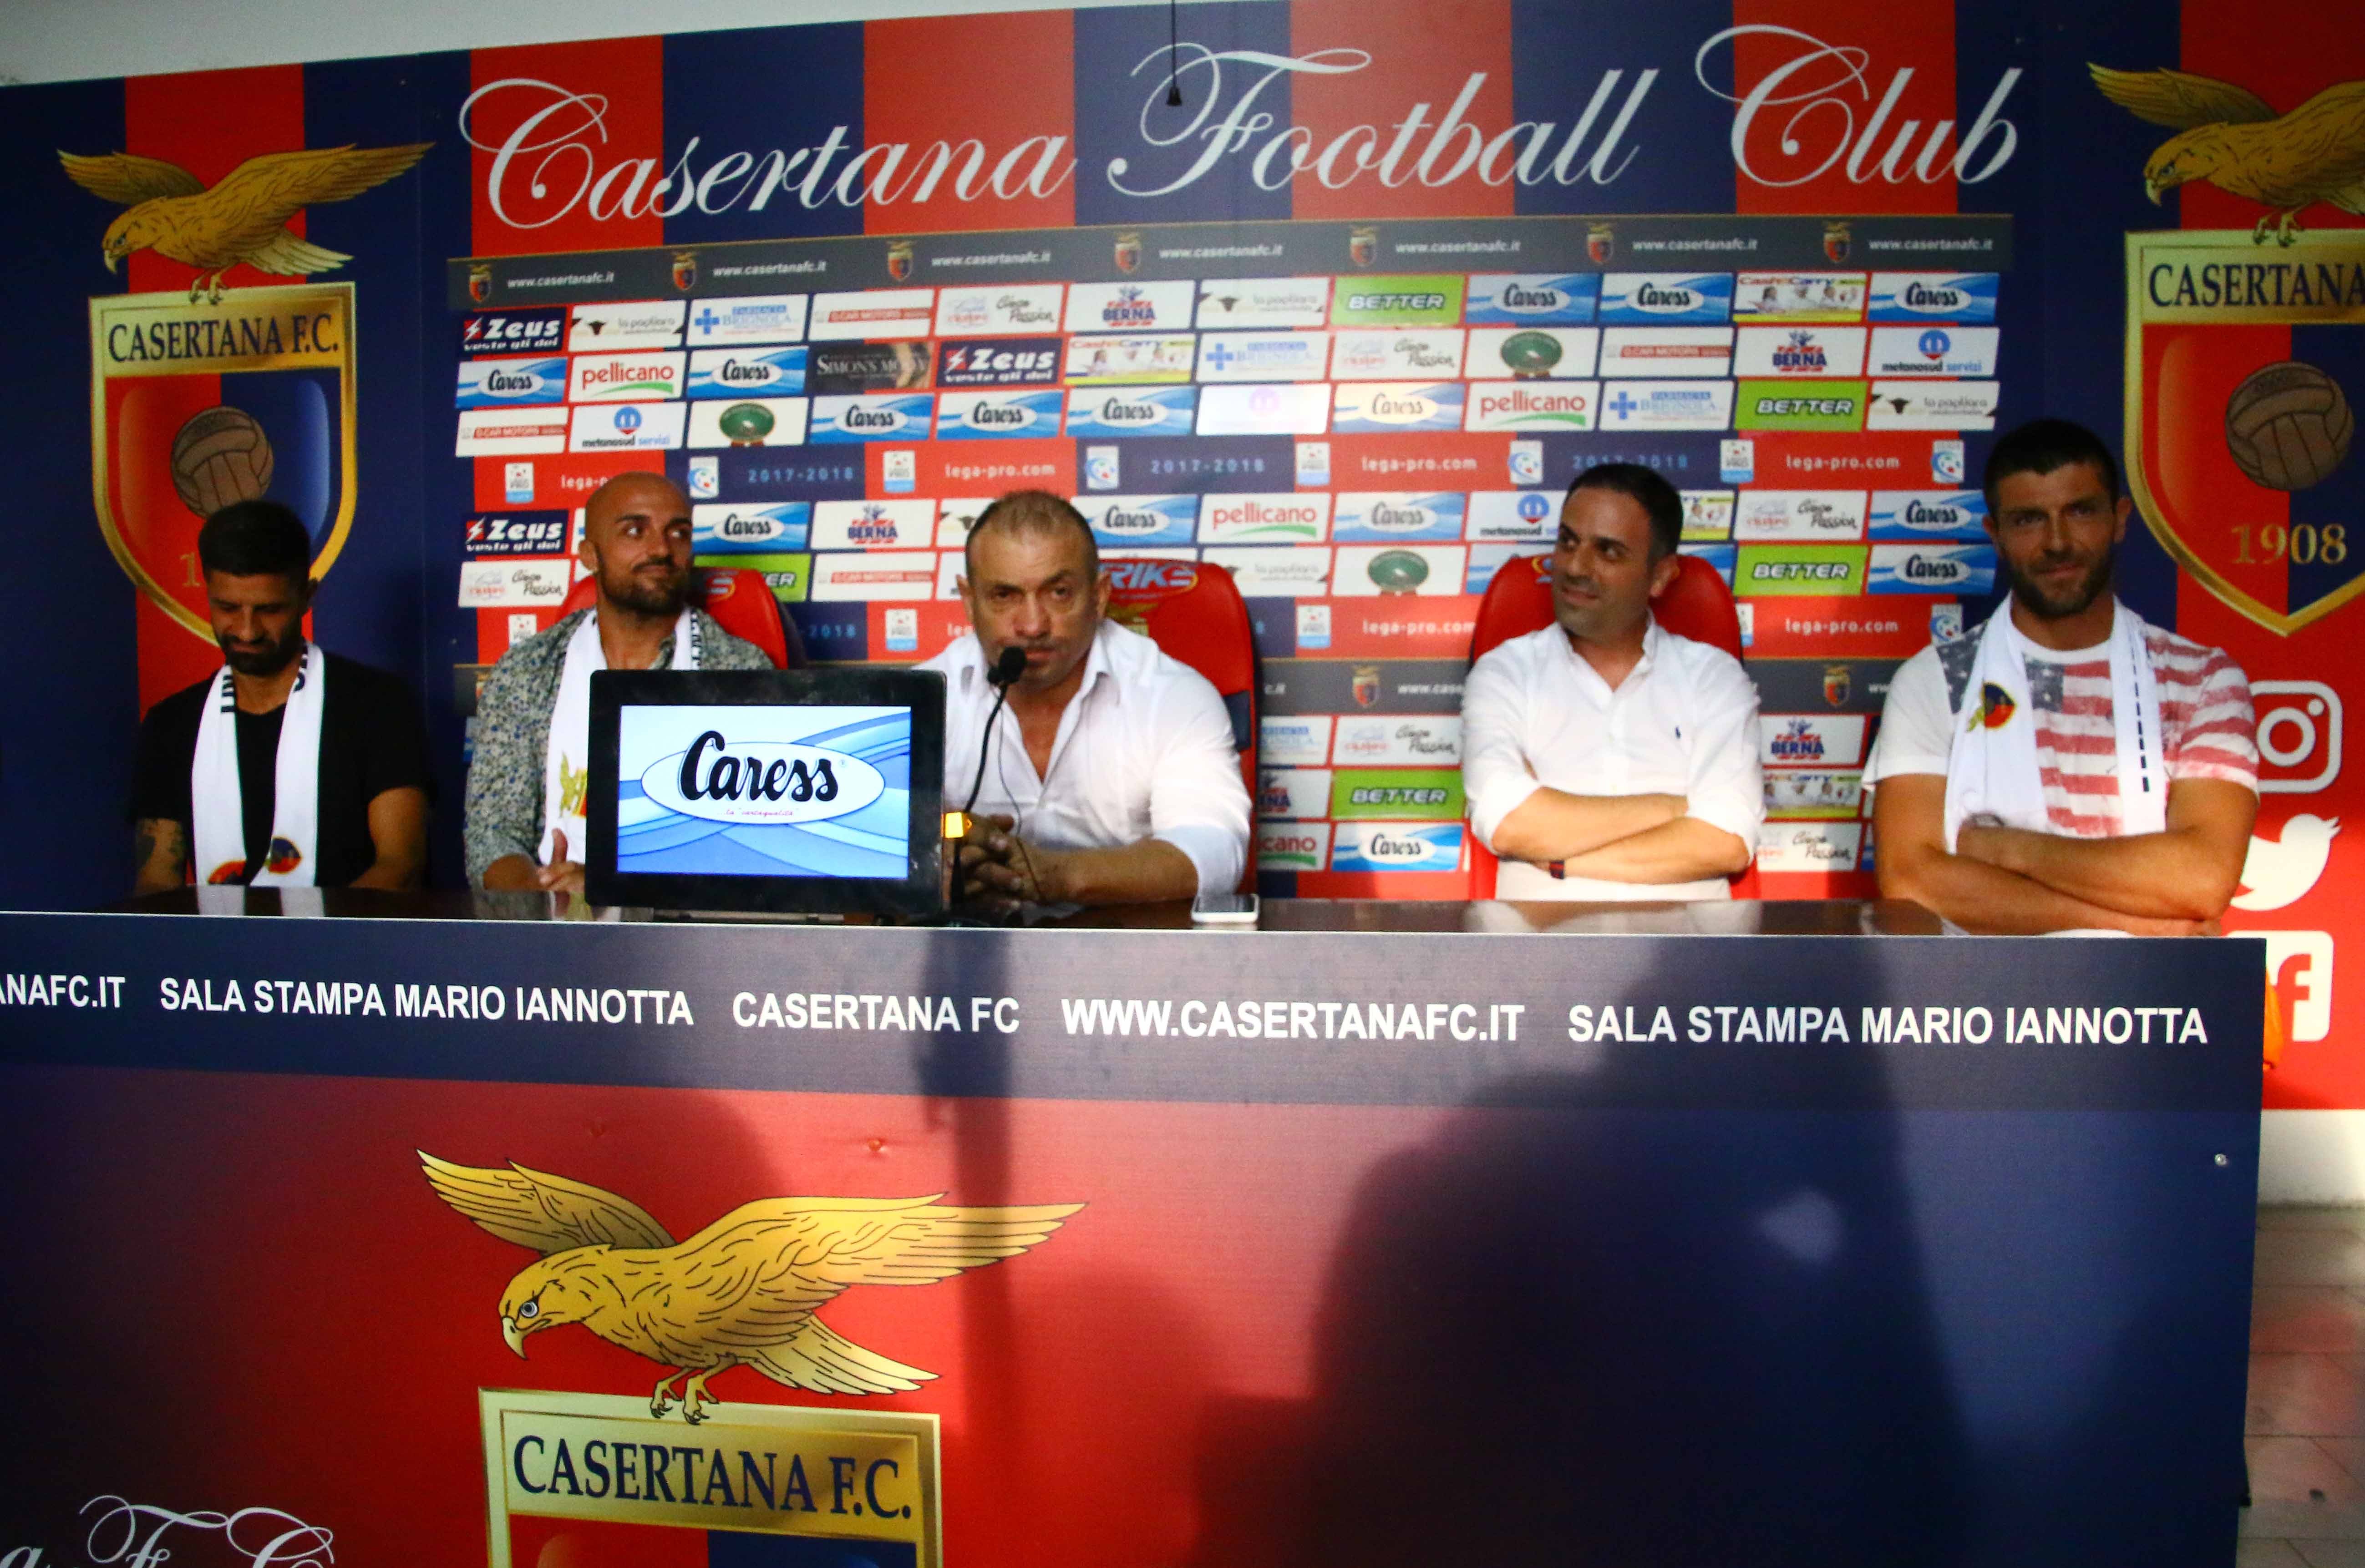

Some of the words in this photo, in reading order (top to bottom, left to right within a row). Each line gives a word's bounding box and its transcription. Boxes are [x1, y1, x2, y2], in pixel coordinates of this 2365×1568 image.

[458, 78, 1077, 229] Casertana
[1107, 42, 1660, 197] Football
[1695, 24, 2023, 187] Club
[1159, 244, 1284, 258] www.casertanafc.it
[1396, 239, 1521, 254] www.casertanafc.it
[1633, 238, 1758, 251] www.casertanafc.it
[1869, 238, 1993, 251] www.casertanafc.it
[712, 260, 827, 276] www.casertanafc.it
[932, 252, 1051, 266] www.casertanafc.it
[508, 271, 614, 288] www.casertanafc.it
[1348, 294, 1444, 310] BETTER
[1503, 283, 1556, 307] Caress
[1638, 282, 1690, 306] Caress
[1905, 281, 1959, 306] Caress
[1102, 307, 1156, 320] BERNA
[109, 316, 284, 362] CASERTANA
[292, 315, 338, 353] F.C.
[484, 318, 561, 339] Zeus
[722, 357, 770, 381] Caress
[968, 348, 1056, 371] Zeus
[1772, 353, 1827, 366] BERNA
[488, 369, 533, 391] Caress
[582, 360, 675, 390] pellicano
[973, 400, 1023, 424] Caress
[1103, 396, 1154, 421] Caress
[1372, 393, 1424, 415] Caress
[1481, 390, 1586, 419] pellicano
[1757, 399, 1853, 414] BETTER
[845, 404, 894, 427] Caress
[945, 463, 1056, 479] lega-pro.com
[1151, 459, 1265, 473] 2017-2018
[1361, 457, 1478, 473] lega-pro.com
[1786, 455, 1900, 470] lega-pro.com
[748, 467, 854, 484] 2017-2018
[1105, 505, 1156, 529] Caress
[1213, 502, 1316, 531] pellicano
[1371, 501, 1424, 526] Caress
[1905, 500, 1958, 523] Caress
[487, 519, 563, 540] Zeus
[724, 513, 772, 535] Caress
[848, 527, 898, 538] BERNA
[2231, 523, 2348, 565] 1908
[1754, 564, 1848, 578] BETTER
[1905, 554, 1958, 577] Caress
[1786, 618, 1899, 634] lega-pro.com
[1771, 741, 1824, 754] BERNA
[679, 731, 839, 802] Caress
[1352, 789, 1446, 804] BETTER
[1371, 833, 1421, 855] Caress
[160, 977, 246, 1012] SALA
[254, 979, 386, 1017] STAMPA
[394, 984, 506, 1020] MARIO
[516, 987, 694, 1025] IANNOTTA
[732, 992, 961, 1032] CASERTANA
[970, 997, 1020, 1034] FC
[1061, 998, 1525, 1041] WWW.CASERTANAFC.IT
[1568, 1005, 1677, 1043] SALA
[1687, 1005, 1850, 1043] STAMPA
[1861, 1007, 1993, 1045] MARIO
[2005, 1007, 2208, 1045] IANNOTTA
[513, 1434, 819, 1512] CASERTANA
[828, 1456, 911, 1520] F.C.
